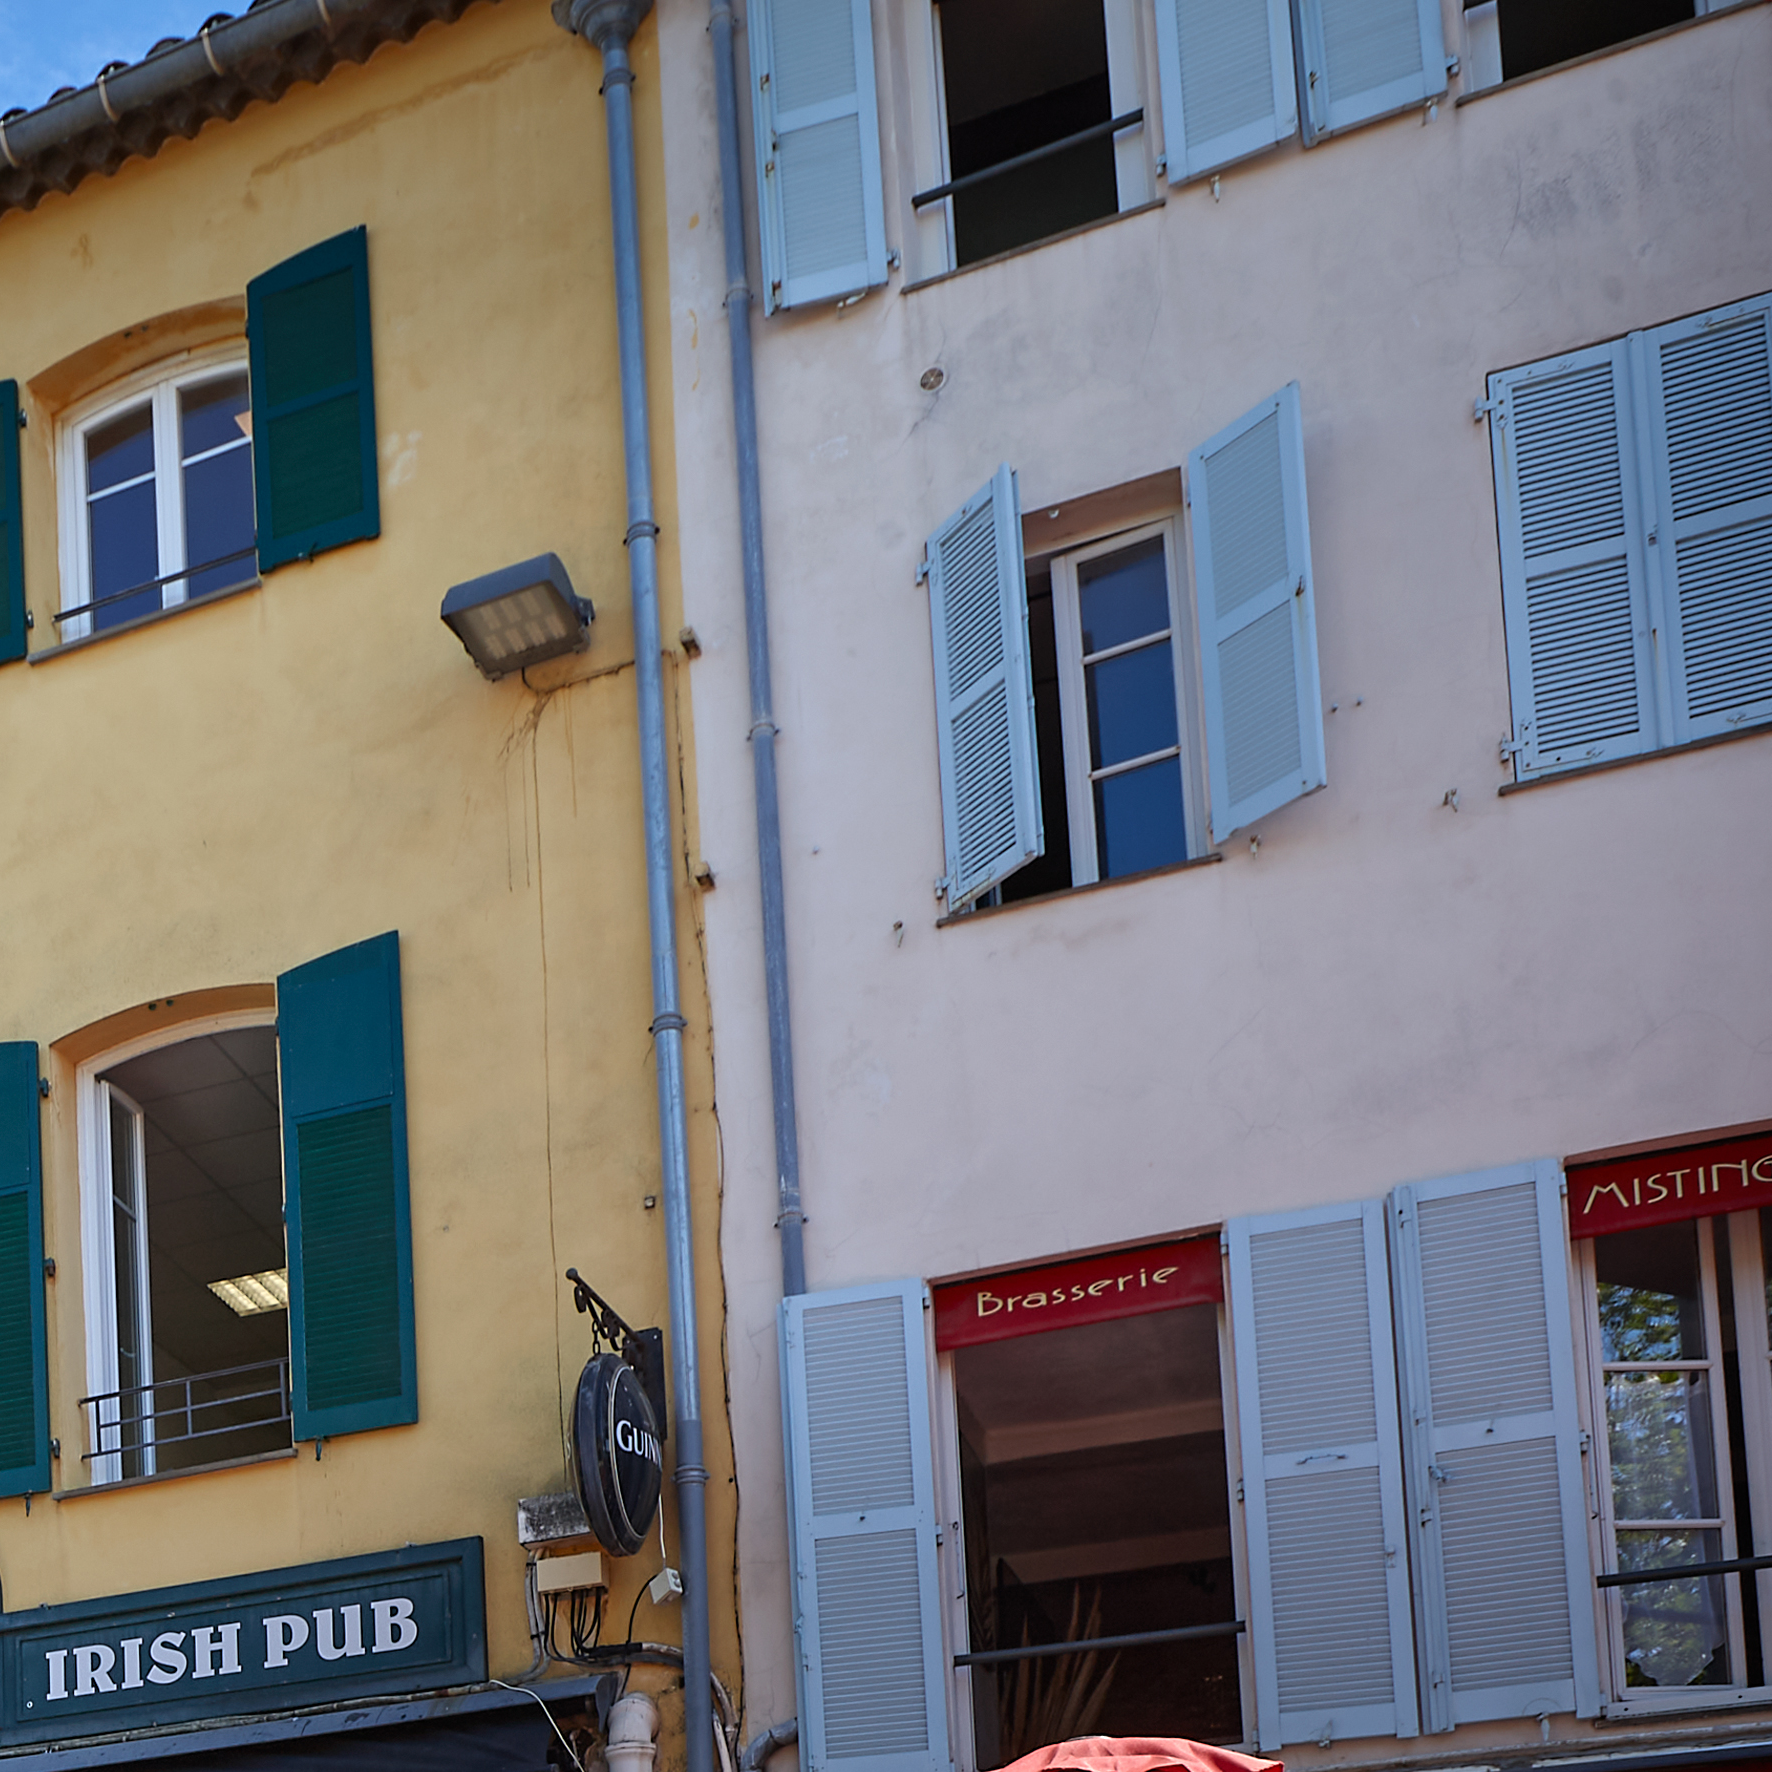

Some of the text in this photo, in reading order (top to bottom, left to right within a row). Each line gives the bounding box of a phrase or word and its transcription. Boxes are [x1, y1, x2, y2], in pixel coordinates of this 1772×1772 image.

[977, 1266, 1180, 1317] Brasserie
[45, 1597, 418, 1701] IRISH PUB
